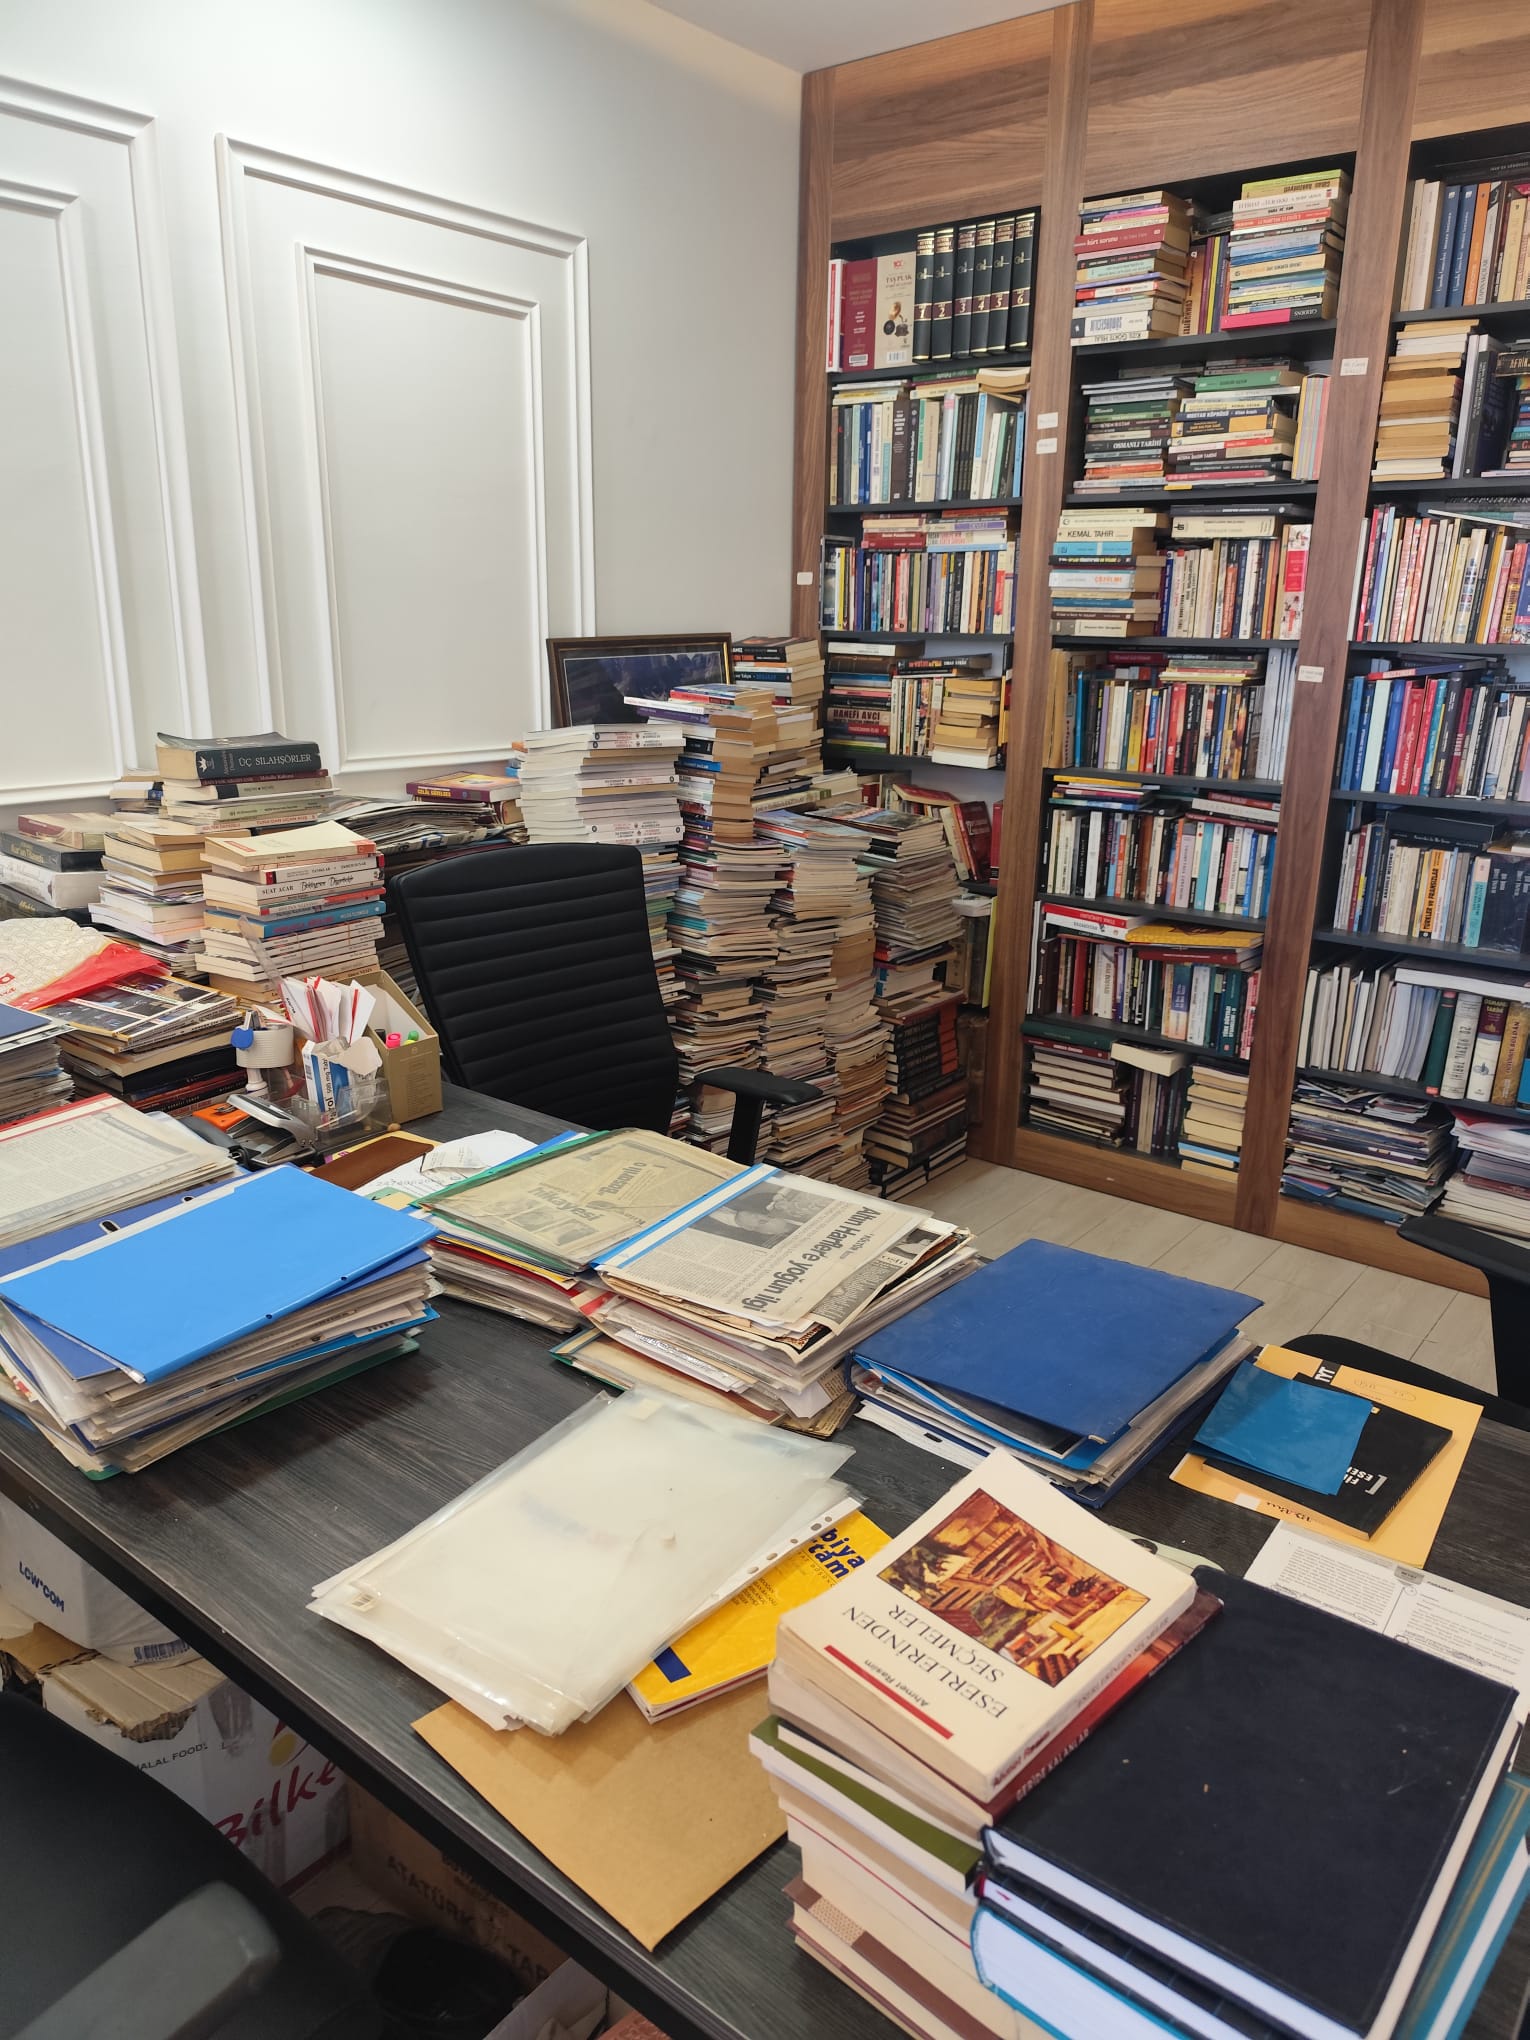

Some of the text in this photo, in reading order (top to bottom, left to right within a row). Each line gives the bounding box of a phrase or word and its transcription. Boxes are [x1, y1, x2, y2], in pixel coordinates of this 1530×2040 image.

[960, 302, 967, 314] 3
[977, 299, 985, 311] 4
[995, 296, 1002, 307] 5
[1016, 293, 1024, 305] 6
[920, 304, 926, 319] 1
[938, 306, 946, 318] 2
[238, 754, 312, 767] ÜÇ SİLAHŞÖRLER
[849, 1206, 881, 1227] Altın
[766, 1258, 814, 1296] yoğun
[741, 1292, 783, 1313] ilgi
[1314, 1365, 1336, 1383] TYT
[888, 1603, 1005, 1684] SEÇMELER
[842, 1604, 1008, 1719] ESERLERİNDEN
[862, 1656, 931, 1709] Ahmet Rasim
[1016, 1728, 1090, 1801] GERİDE KALANLAR
